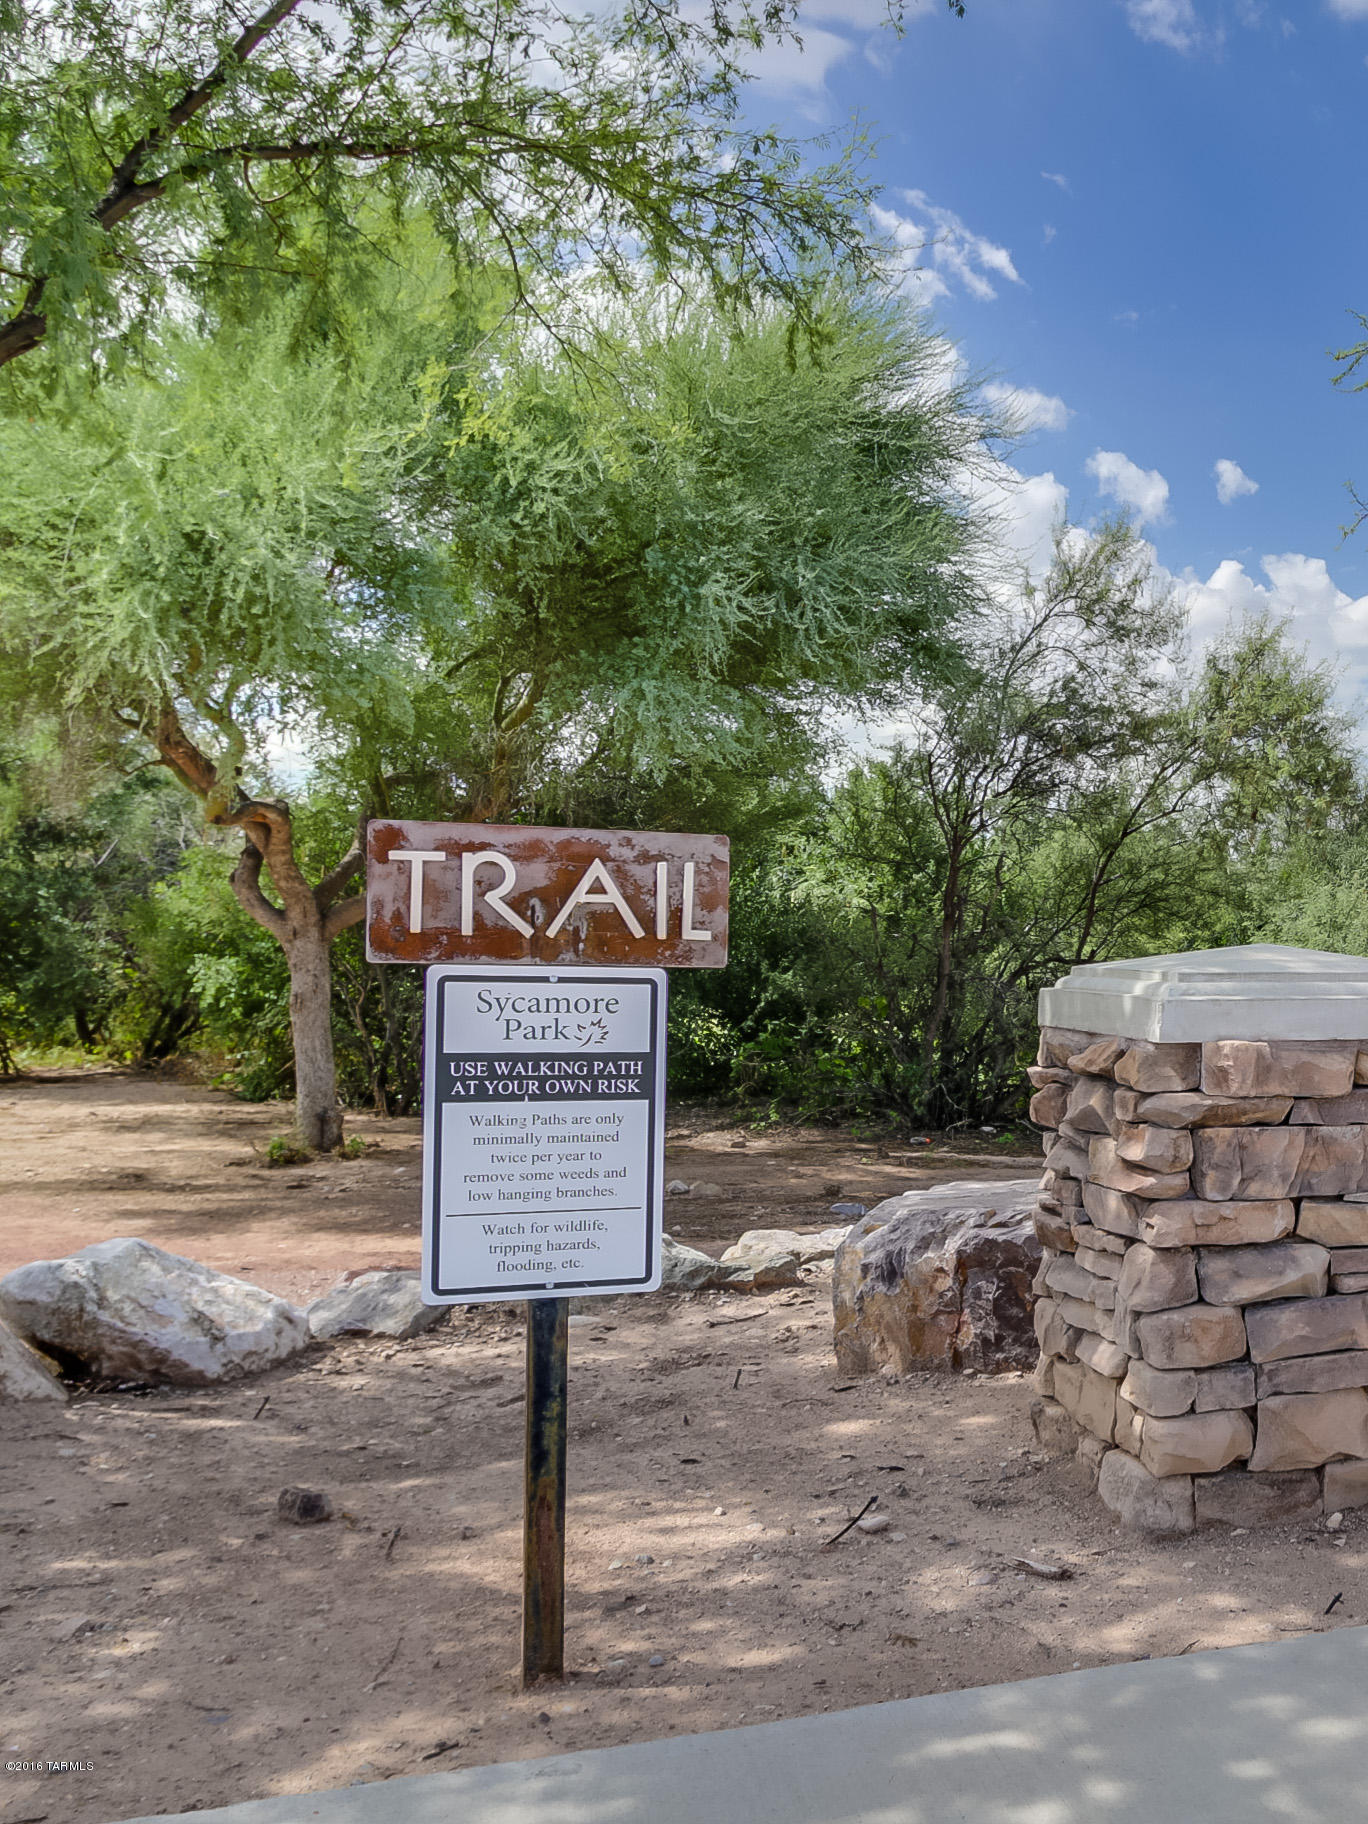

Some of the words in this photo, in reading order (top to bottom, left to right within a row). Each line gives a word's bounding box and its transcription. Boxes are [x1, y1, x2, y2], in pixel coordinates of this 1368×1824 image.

[388, 849, 713, 941] TRAIL
[476, 989, 620, 1022] Sycamore
[502, 1018, 571, 1040] Park
[450, 1062, 488, 1077] USE
[494, 1061, 588, 1075] WALKING
[593, 1060, 643, 1075] PATH
[450, 1080, 479, 1095] AT
[484, 1080, 540, 1095] YOUR
[546, 1079, 592, 1094] OWN
[597, 1079, 641, 1093] RISK
[469, 1114, 527, 1129] Walking
[532, 1114, 567, 1126] Paths
[571, 1114, 591, 1125] are
[596, 1113, 624, 1127] only
[473, 1133, 542, 1147] minimally
[547, 1131, 619, 1144] maintained
[491, 1152, 527, 1164] twice
[531, 1153, 552, 1165] per
[557, 1153, 586, 1164] year
[589, 1152, 602, 1161] to
[463, 1172, 514, 1183] remove
[519, 1171, 554, 1181] some
[559, 1168, 599, 1179] weeds
[603, 1167, 627, 1178] and
[468, 1190, 493, 1201] low
[498, 1188, 552, 1202] hanging
[556, 1186, 617, 1198] branches.
[482, 1223, 525, 1235] Watch
[531, 1222, 550, 1233] for
[554, 1220, 608, 1232] wildlife,
[489, 1242, 542, 1256] tripping
[547, 1239, 600, 1251] hazards,
[497, 1260, 557, 1272] flooding,
[561, 1259, 584, 1269] etc.
